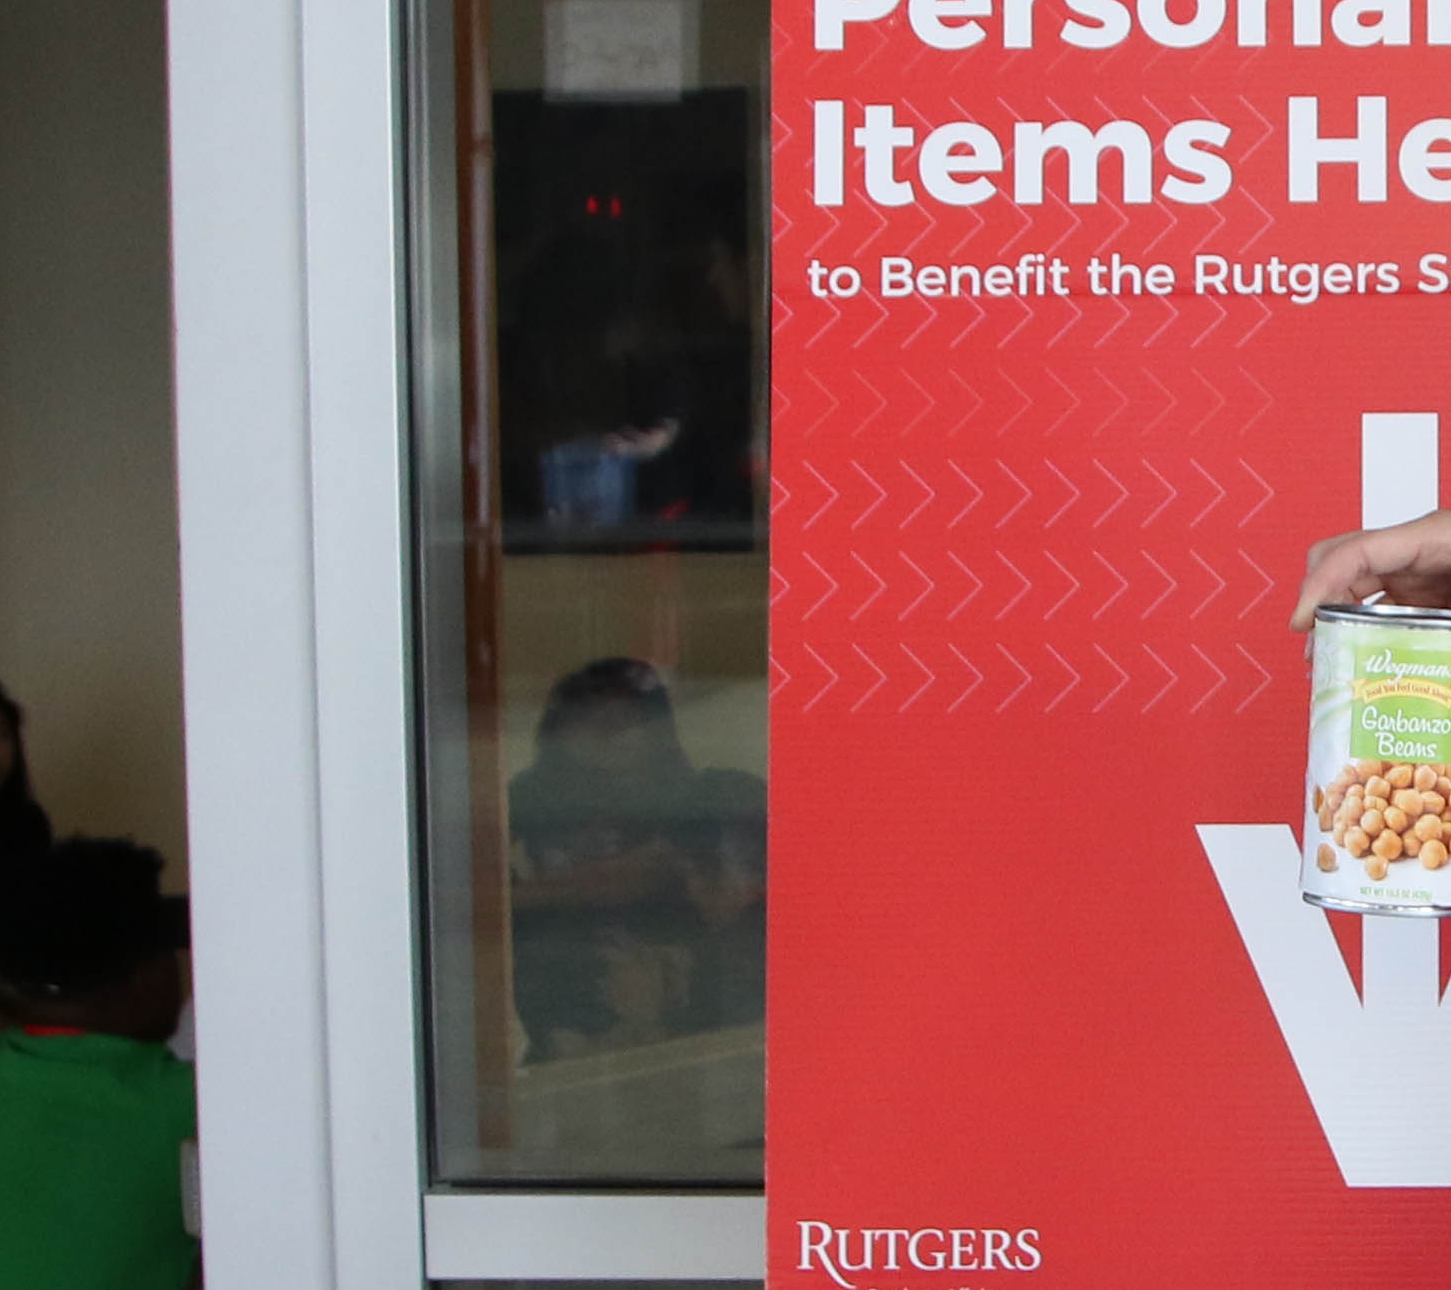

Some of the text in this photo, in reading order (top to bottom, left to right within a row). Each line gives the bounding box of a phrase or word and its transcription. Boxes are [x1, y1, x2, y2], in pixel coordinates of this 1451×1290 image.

[814, 100, 1232, 207] Items
[807, 260, 861, 298] to
[881, 253, 1070, 297] Benefit
[1087, 253, 1175, 296] the
[1195, 254, 1400, 305] Rutgers
[1362, 706, 1451, 734] Garbanzo
[1376, 732, 1438, 757] Beans
[797, 1221, 1042, 1290] RUTGERS
